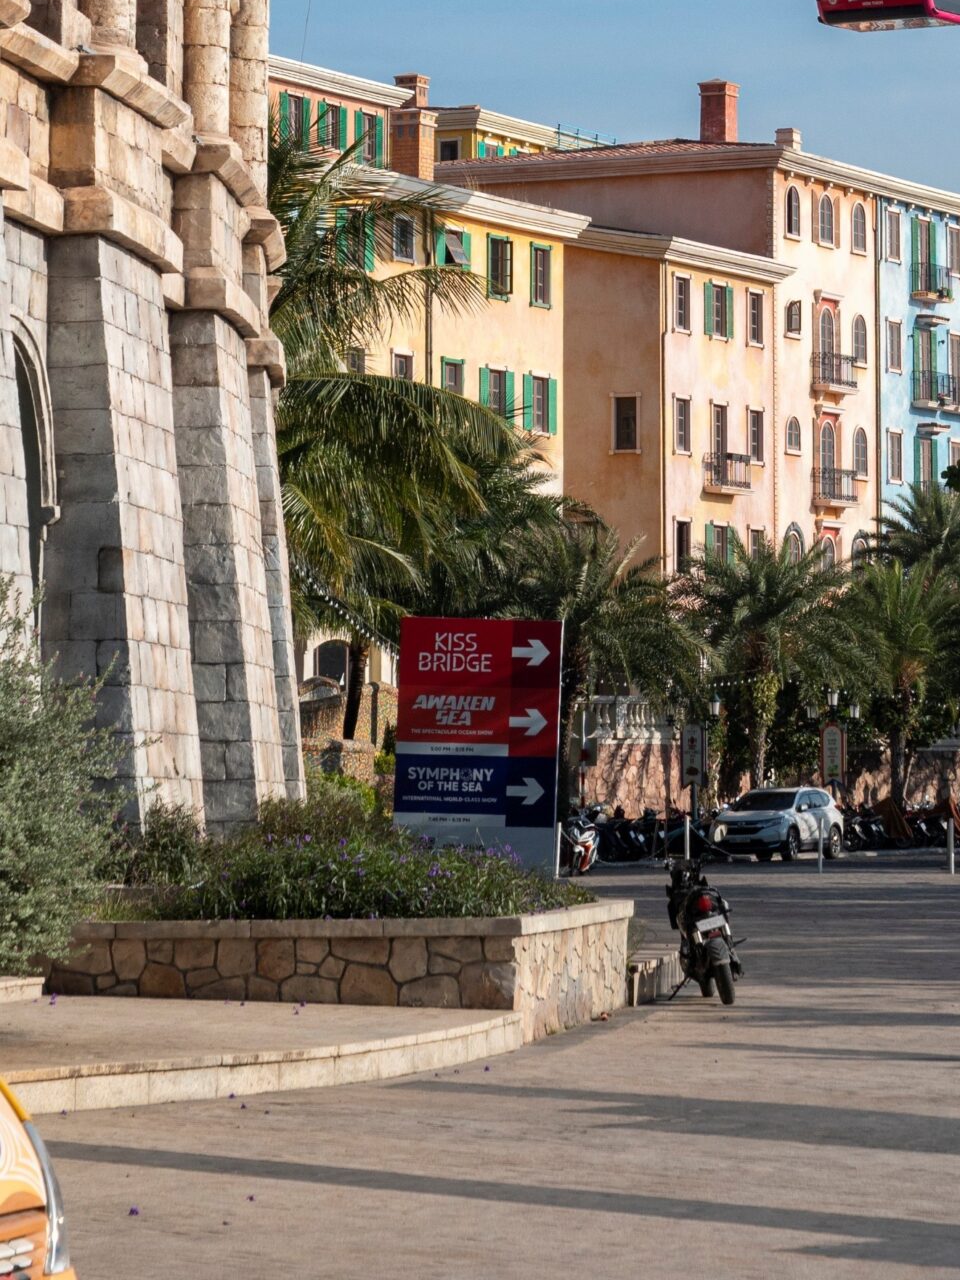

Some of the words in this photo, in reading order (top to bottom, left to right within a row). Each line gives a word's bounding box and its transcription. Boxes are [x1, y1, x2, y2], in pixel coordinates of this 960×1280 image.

[435, 632, 478, 651] KISS
[418, 652, 494, 672] BRIDGE
[411, 694, 496, 711] AWAKEN
[436, 711, 472, 726] SEA
[407, 766, 494, 782] SYMPHONY
[417, 780, 434, 791] OF
[437, 781, 459, 792] THE
[461, 781, 483, 793] SEA
